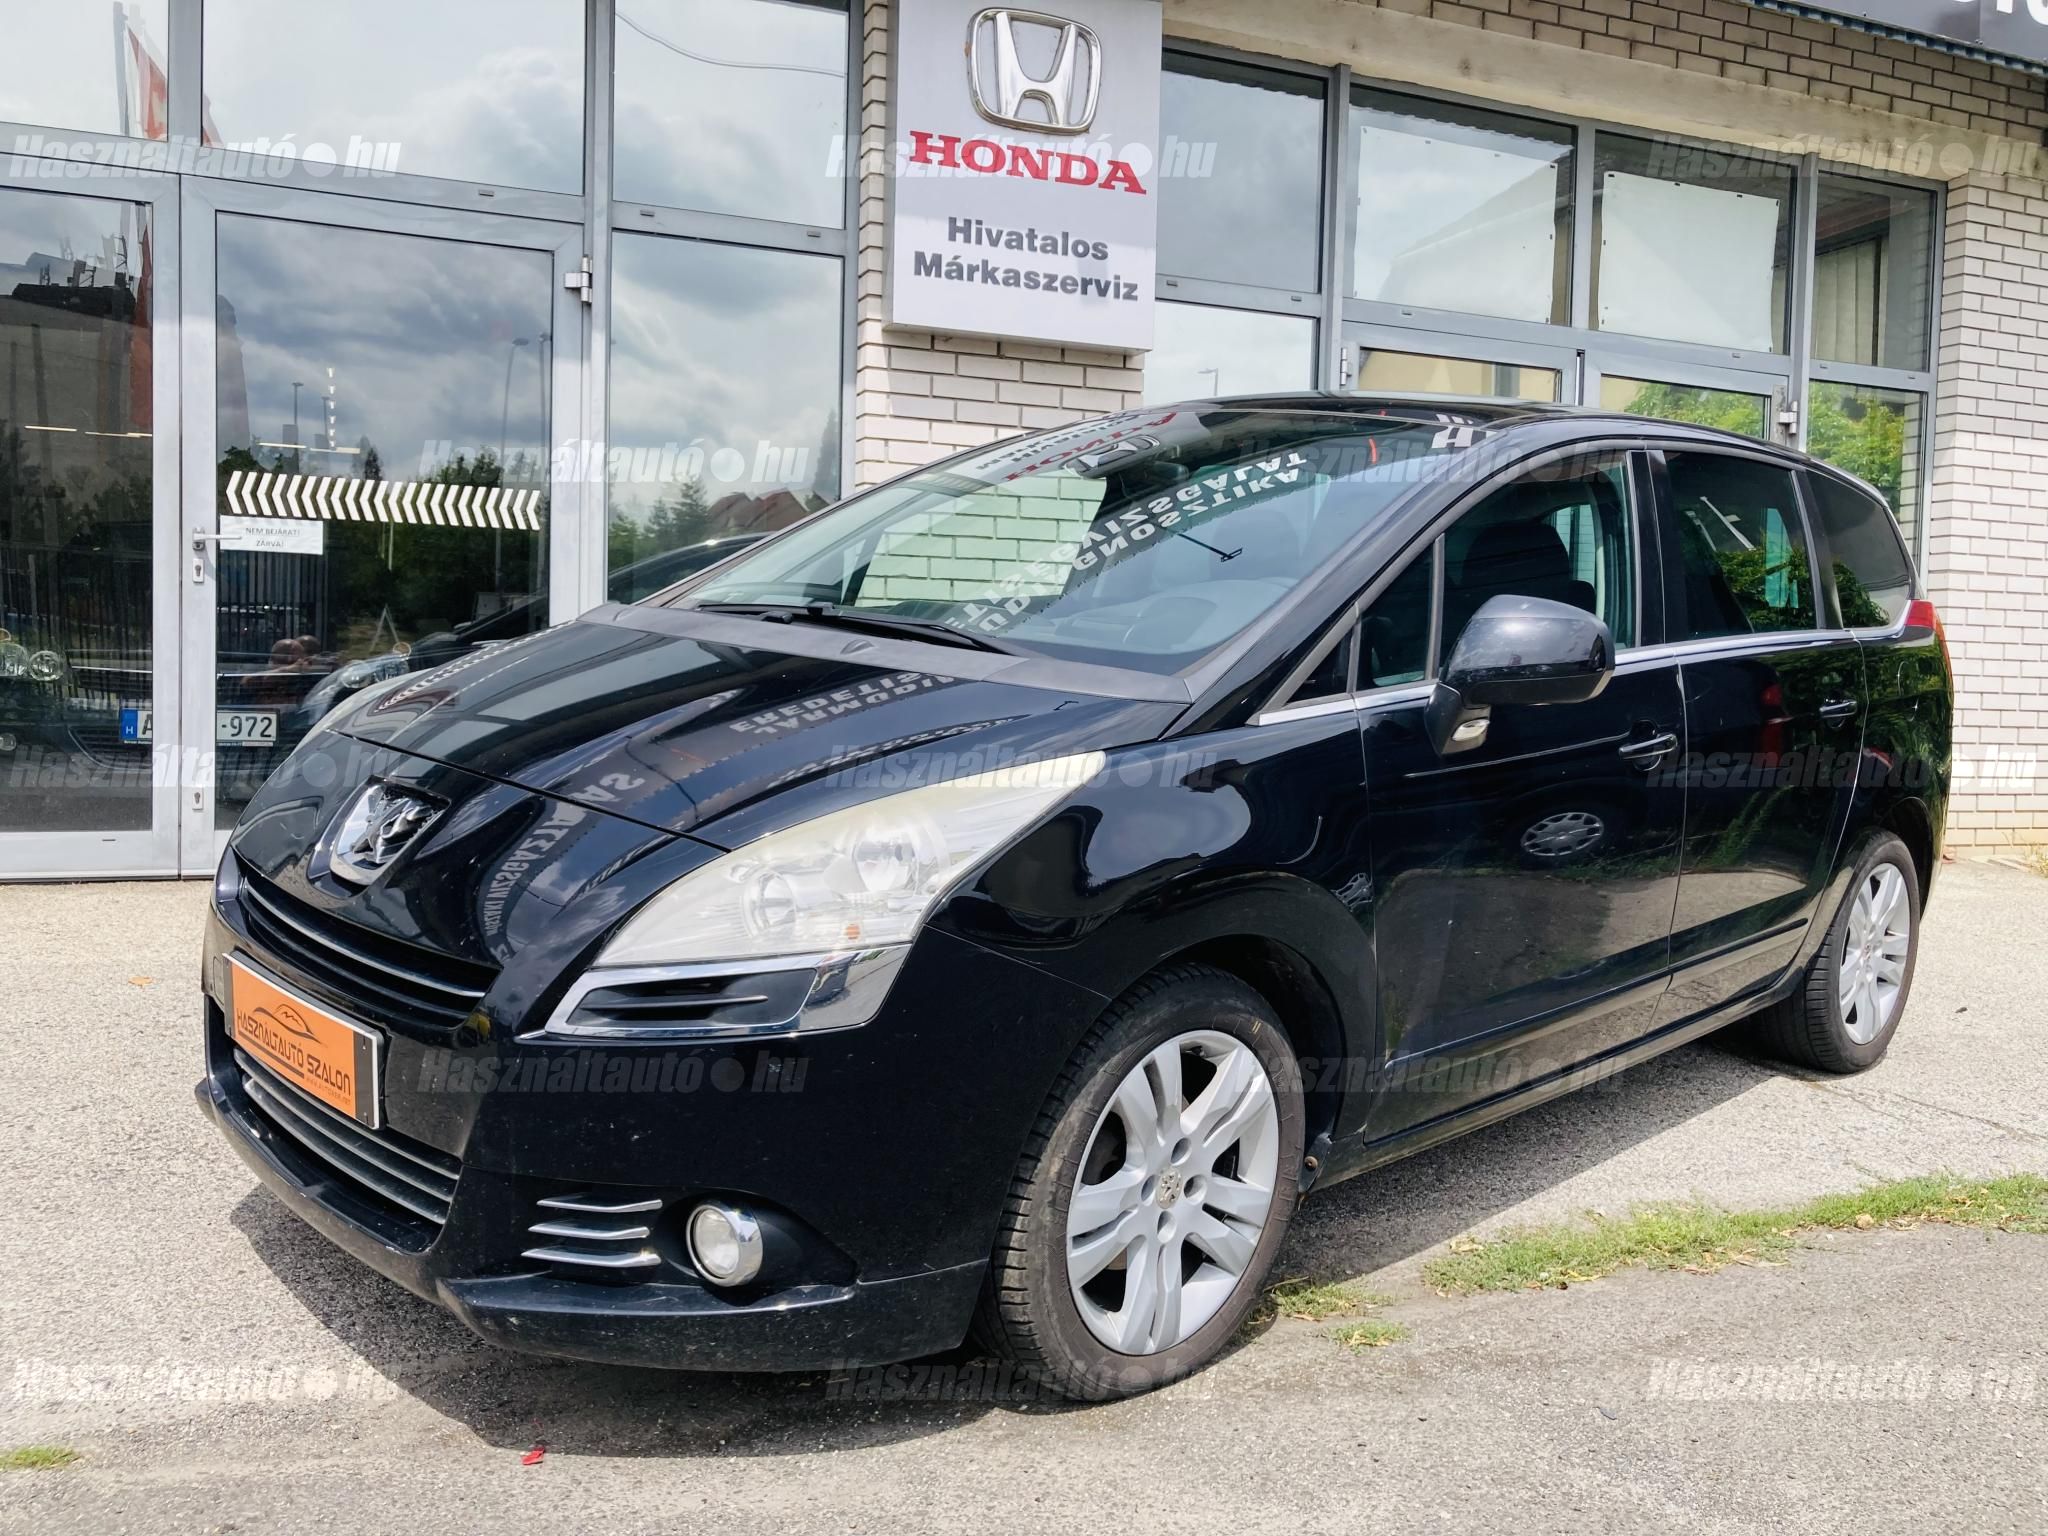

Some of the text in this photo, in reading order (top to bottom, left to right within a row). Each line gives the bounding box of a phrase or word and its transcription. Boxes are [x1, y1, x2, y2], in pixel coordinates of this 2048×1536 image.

[909, 131, 1147, 195] HONDA
[948, 217, 1109, 262] Hivatalos
[913, 250, 1138, 301] Márkaszerviz
[307, 1053, 351, 1096] SZALON
